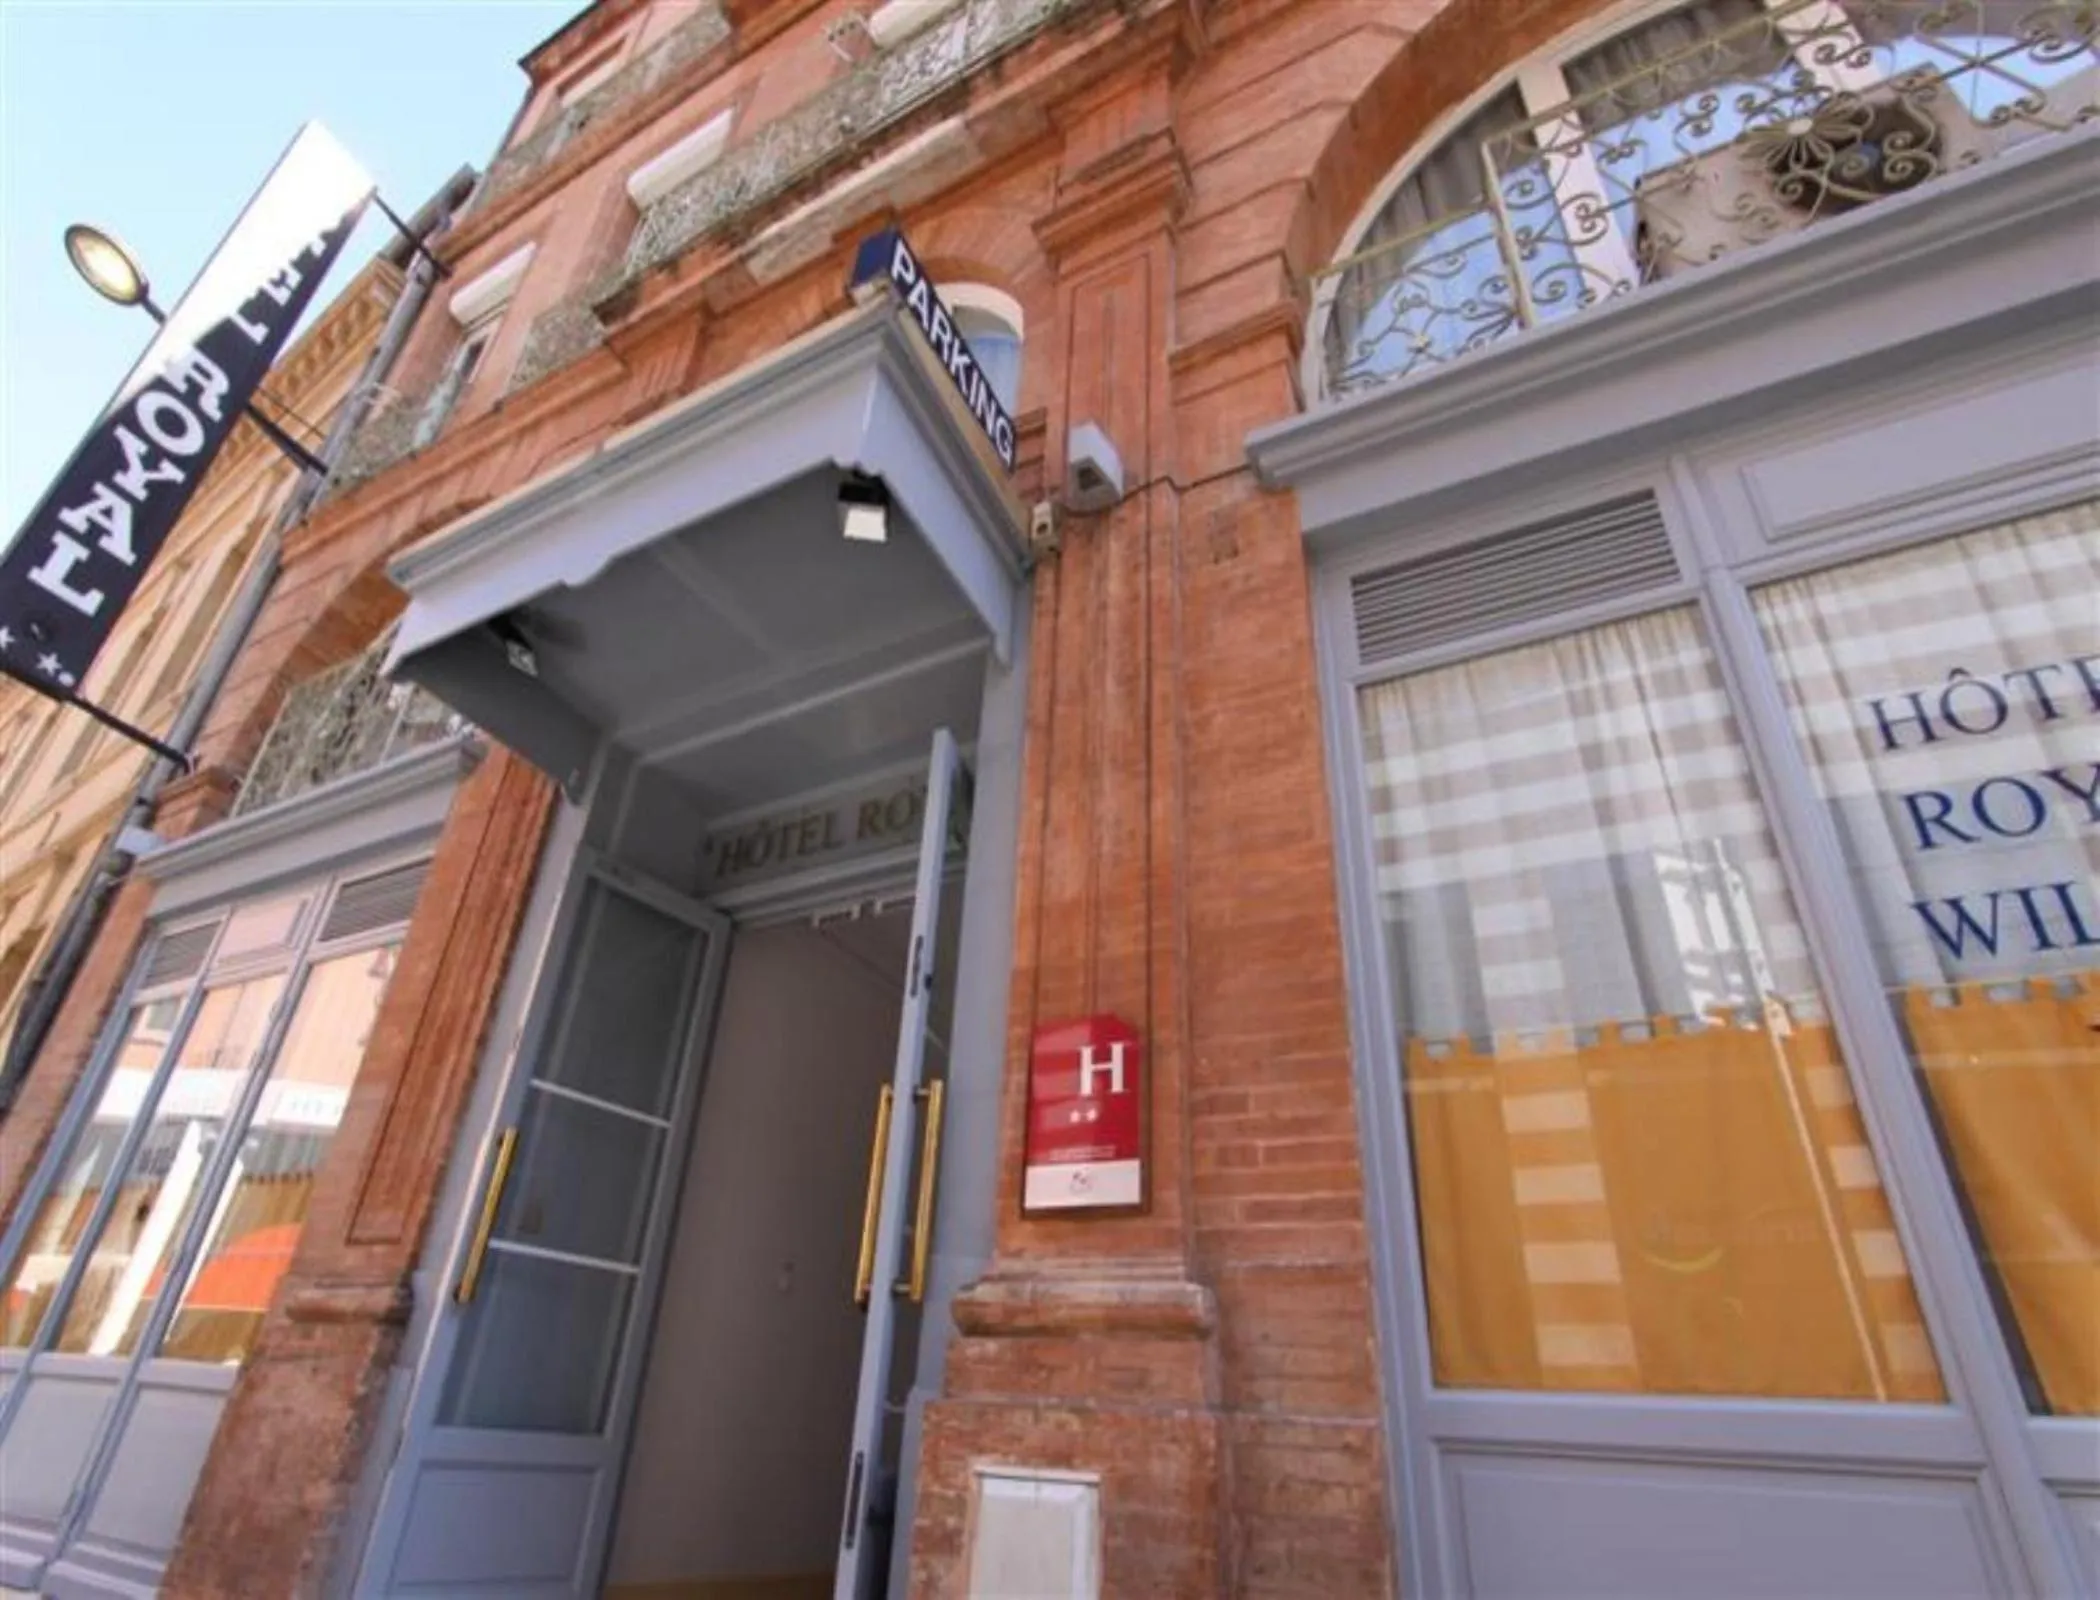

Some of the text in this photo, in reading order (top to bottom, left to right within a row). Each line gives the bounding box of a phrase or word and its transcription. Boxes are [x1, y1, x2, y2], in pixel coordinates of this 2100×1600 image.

[891, 238, 1012, 465] PARKING
[27, 345, 230, 617] ROYAL
[1903, 762, 2100, 850] ROY
[1910, 880, 2100, 961] WIL
[1079, 1041, 1132, 1097] H
